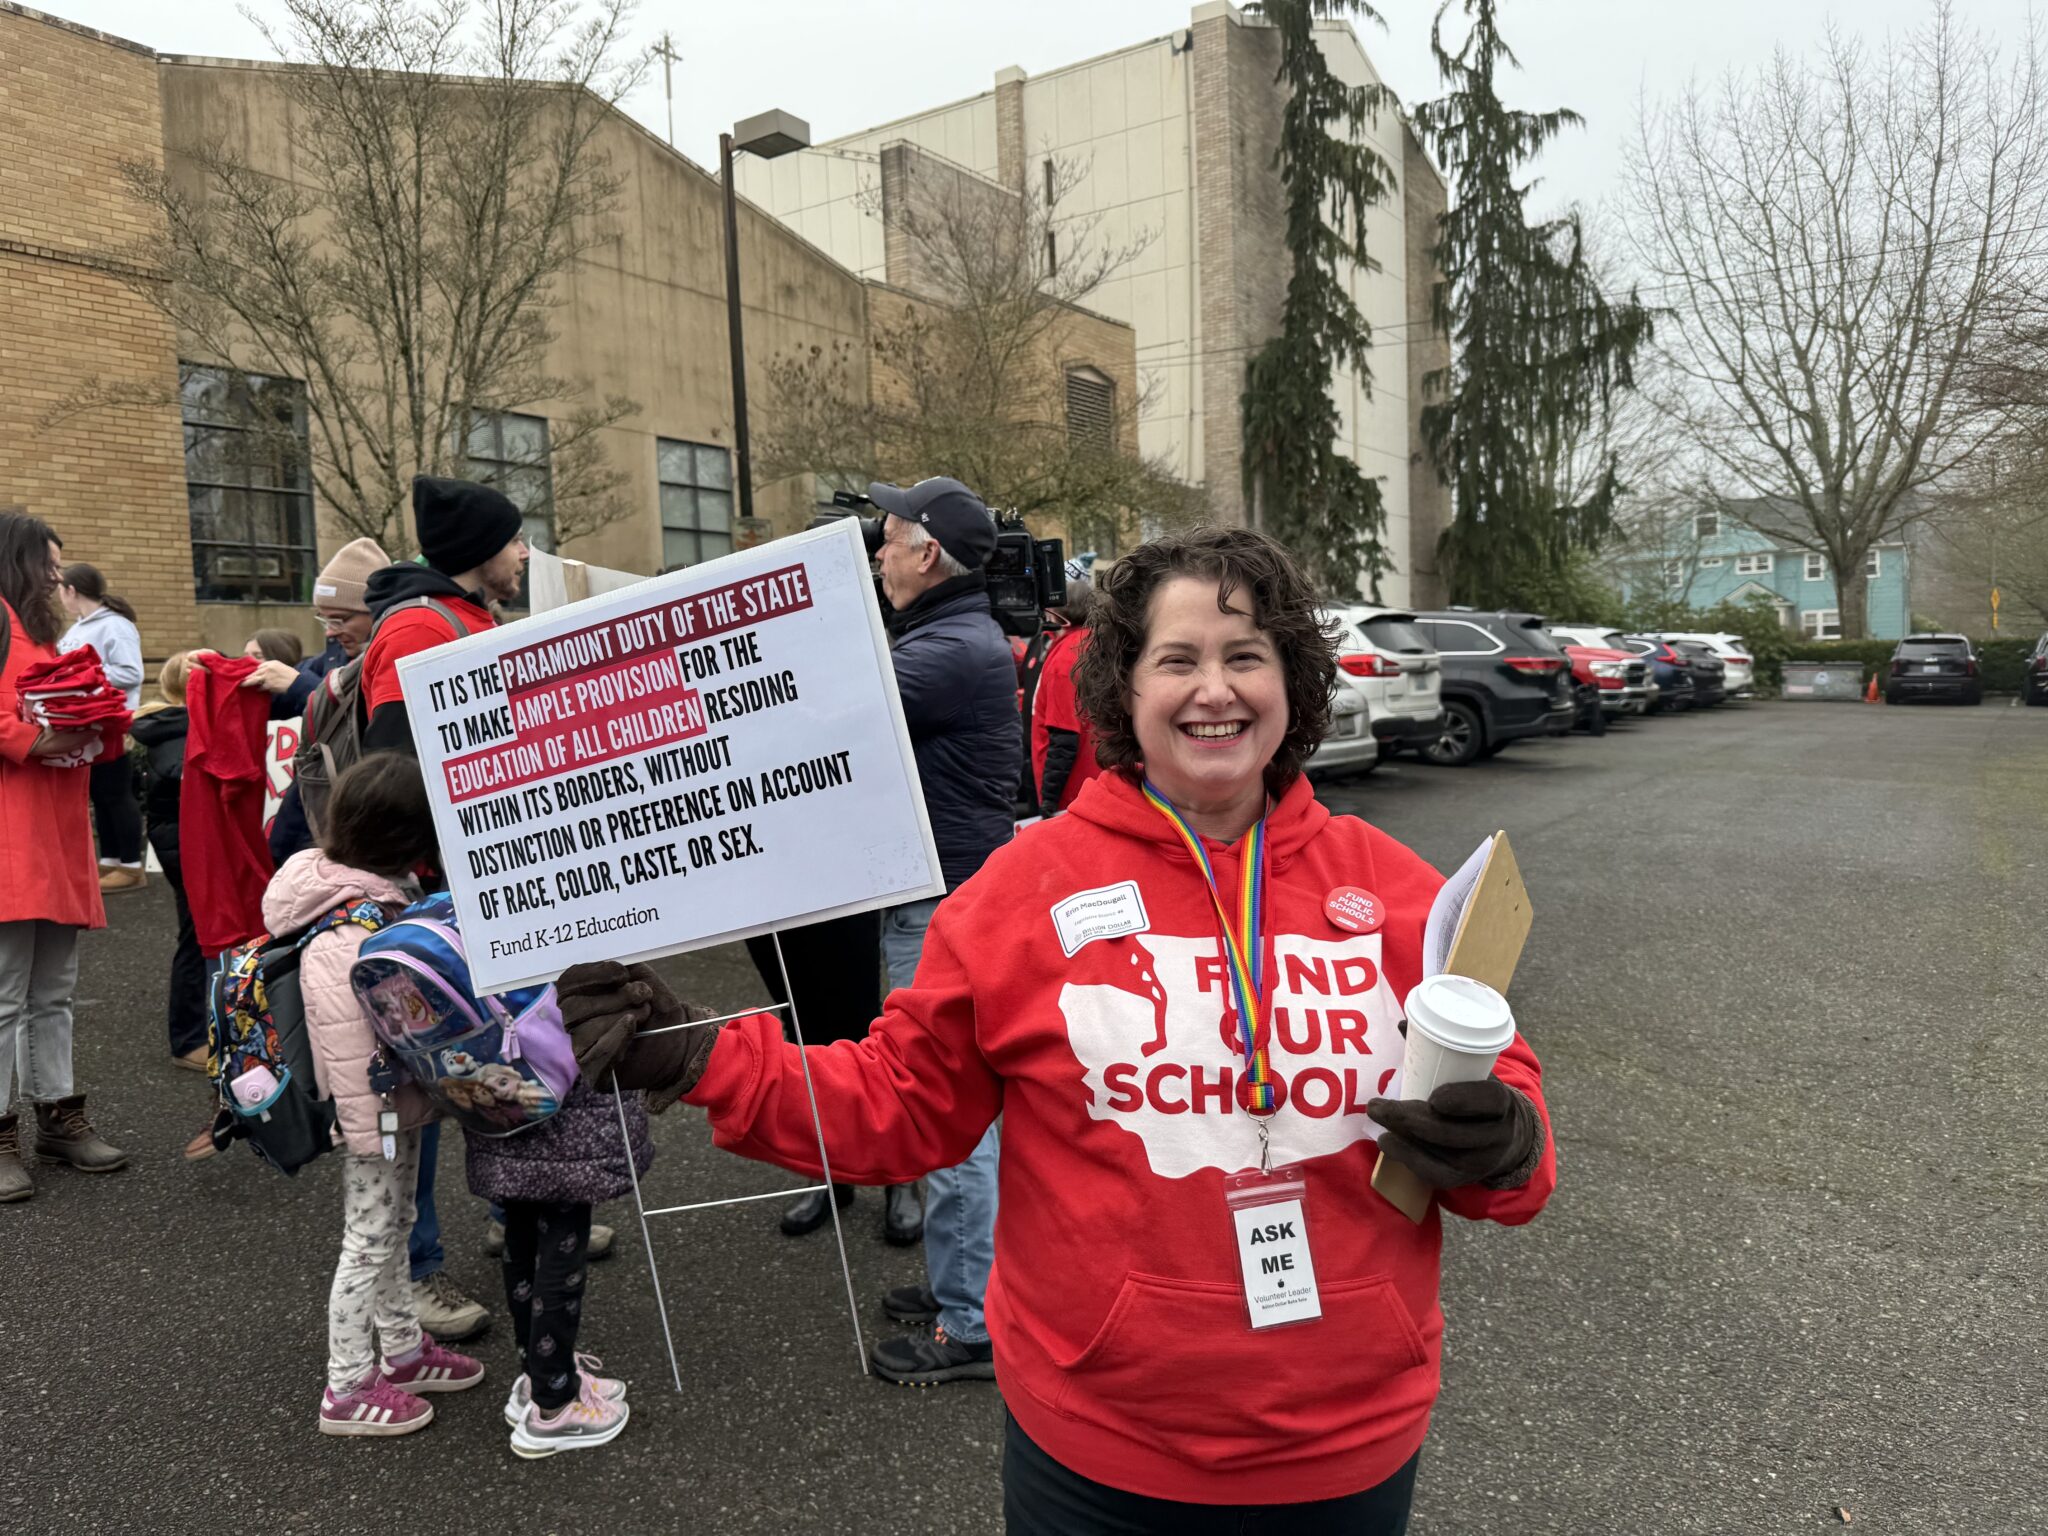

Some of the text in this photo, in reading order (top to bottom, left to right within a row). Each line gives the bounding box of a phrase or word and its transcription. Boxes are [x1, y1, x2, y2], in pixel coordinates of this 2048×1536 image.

[429, 570, 808, 712] IT IS THE PARAMOUNT DUTY OF THE STATE
[438, 631, 762, 753] TO MAKE AMPLE PROVISION FOR THE
[448, 670, 798, 796] EDUCATION OF ALL CHILDREN RESIDING
[457, 734, 731, 837] WITHIN ITS BORDERS, WITHOUT
[468, 750, 852, 879] DISTINCTION OR PREFERENCE ON ACCOUNT
[478, 823, 764, 920] OF RACE, COLOR, CASTE, OR SEX.
[1065, 905, 1080, 917] Erin
[1329, 901, 1375, 925] SCHOOLS
[1338, 896, 1374, 916] PUBLIC
[1346, 892, 1373, 907] FUND
[489, 906, 660, 959] Fund K-12 Education
[1194, 953, 1378, 996] FND
[1250, 1221, 1296, 1245] ASK
[1261, 1252, 1295, 1274] ME
[1254, 1287, 1311, 1303] Volunteer Leader
